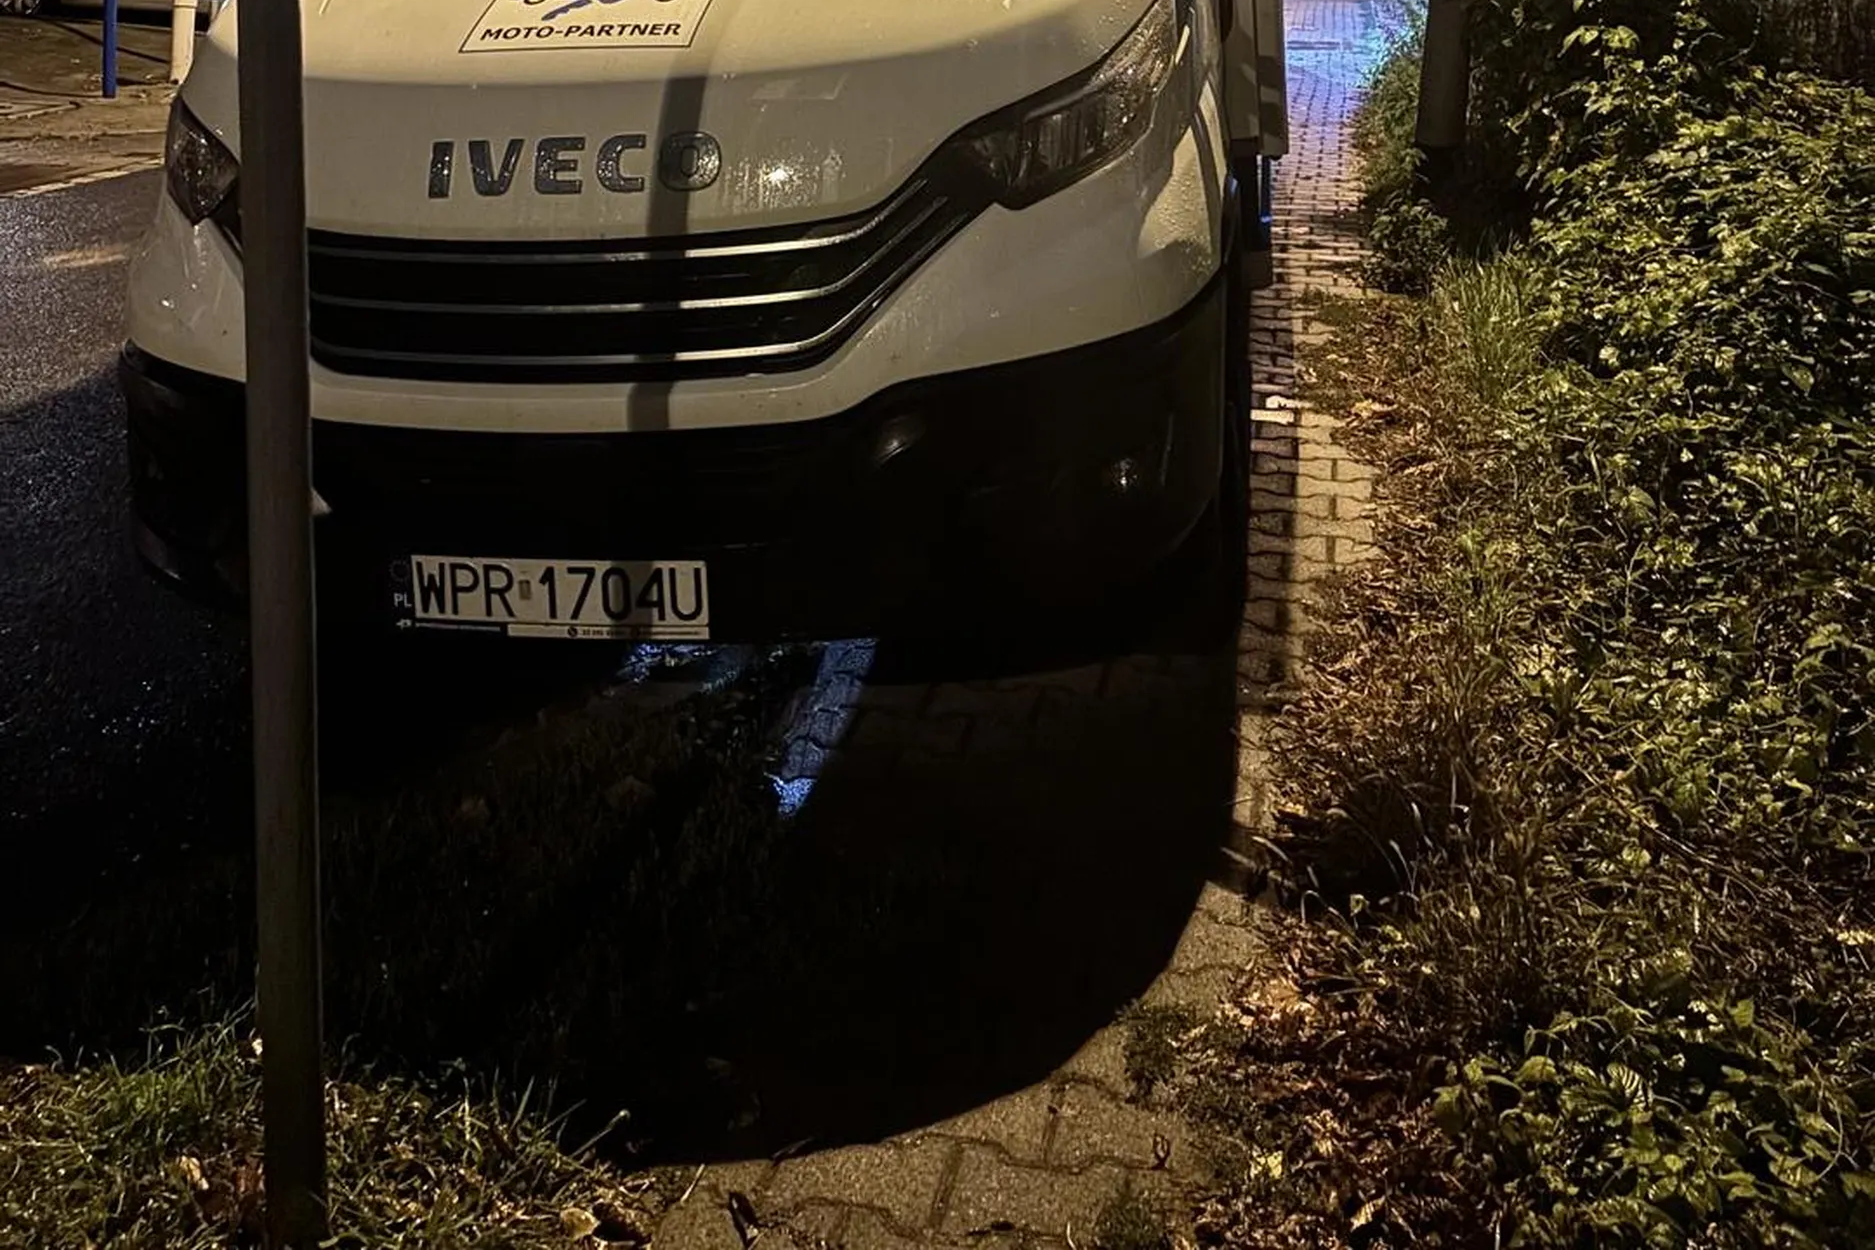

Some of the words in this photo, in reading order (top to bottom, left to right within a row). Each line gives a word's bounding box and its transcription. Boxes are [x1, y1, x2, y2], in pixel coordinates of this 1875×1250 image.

[480, 23, 682, 41] MOTO-PARTNER
[428, 130, 722, 198] IVECO
[393, 592, 412, 608] PL
[416, 561, 515, 618] WPR
[539, 566, 704, 622] 1704U
